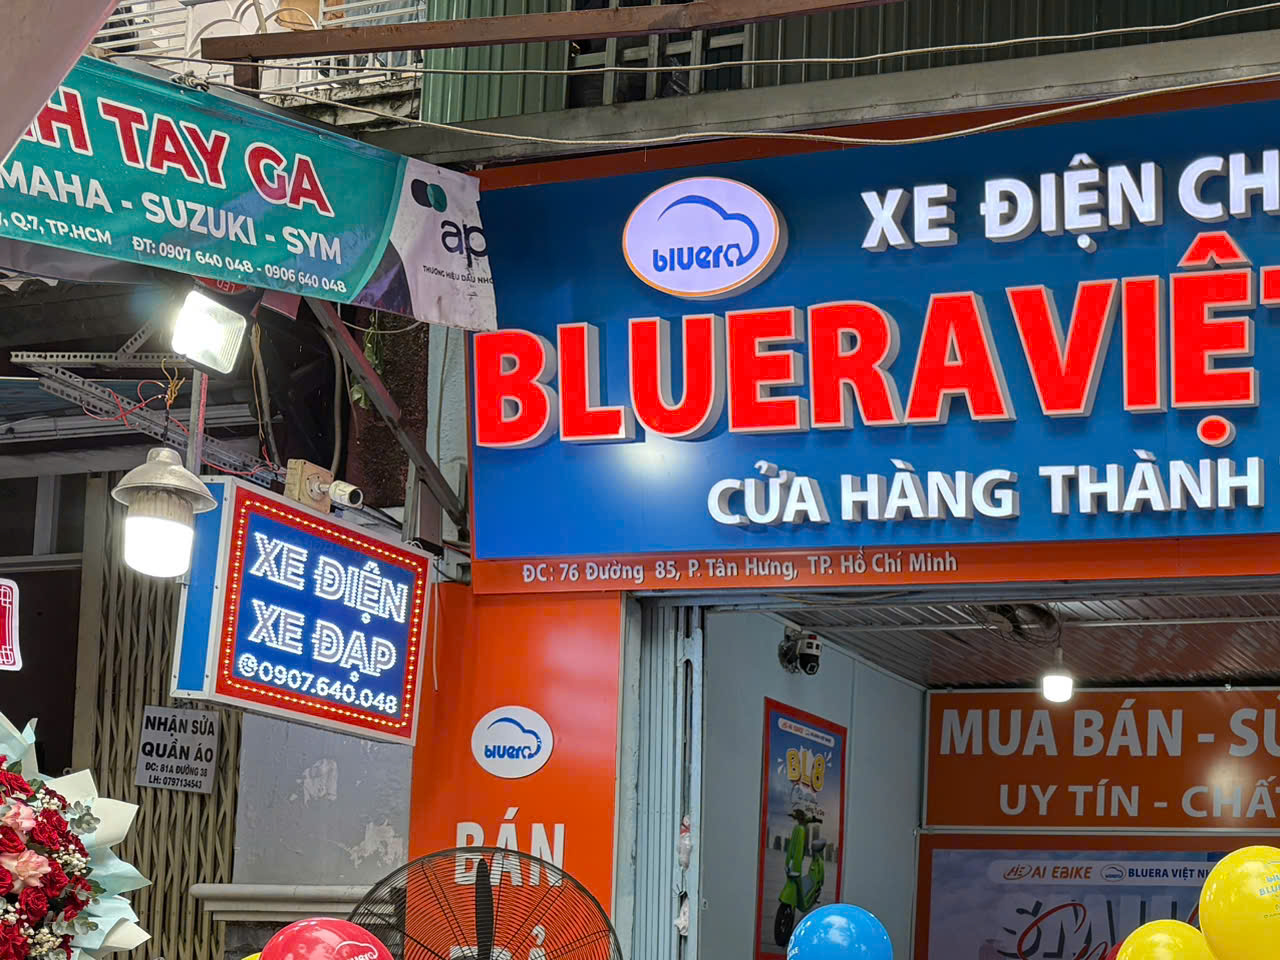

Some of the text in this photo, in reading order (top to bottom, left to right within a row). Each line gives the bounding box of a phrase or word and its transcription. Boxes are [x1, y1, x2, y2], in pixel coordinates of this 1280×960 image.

[20, 86, 335, 217] H TAY GA
[141, 191, 257, 247] SUZUKI
[282, 225, 342, 265] SYM
[861, 183, 957, 251] XE
[980, 153, 1162, 253] ĐIỆN
[45, 217, 112, 246] TP.HCM
[132, 236, 156, 254] ĐT:
[159, 242, 191, 261] 0907
[195, 250, 222, 269] 640
[225, 257, 253, 273] 048
[264, 264, 296, 282] 0906
[298, 271, 319, 288] 640
[321, 276, 347, 293] 048
[473, 291, 1017, 449] BLUERA
[707, 459, 829, 526] CỬA
[841, 458, 1019, 521] HÀNG
[1039, 448, 1265, 516] THÀNH
[250, 531, 410, 625] XE ĐIỆN
[523, 545, 957, 586] ĐC: 76 Đường 85, P. Tân Hưng, TP. Hồ Chí Minh
[248, 599, 398, 682] XE ĐẠP
[258, 660, 399, 714] 0907.640.048
[141, 738, 214, 763] QUẦN ÁO
[144, 714, 215, 737] NHẬN SỬA
[939, 708, 1058, 756] MUA
[1072, 698, 1183, 757] BÁN
[999, 785, 1057, 817] UY
[1068, 778, 1140, 817] TÍN
[455, 807, 565, 887] BÁN
[1031, 866, 1046, 878] AI
[1052, 865, 1093, 879] EBIKE
[1129, 868, 1169, 879] BLUERA
[1172, 867, 1194, 881] VIỆT
